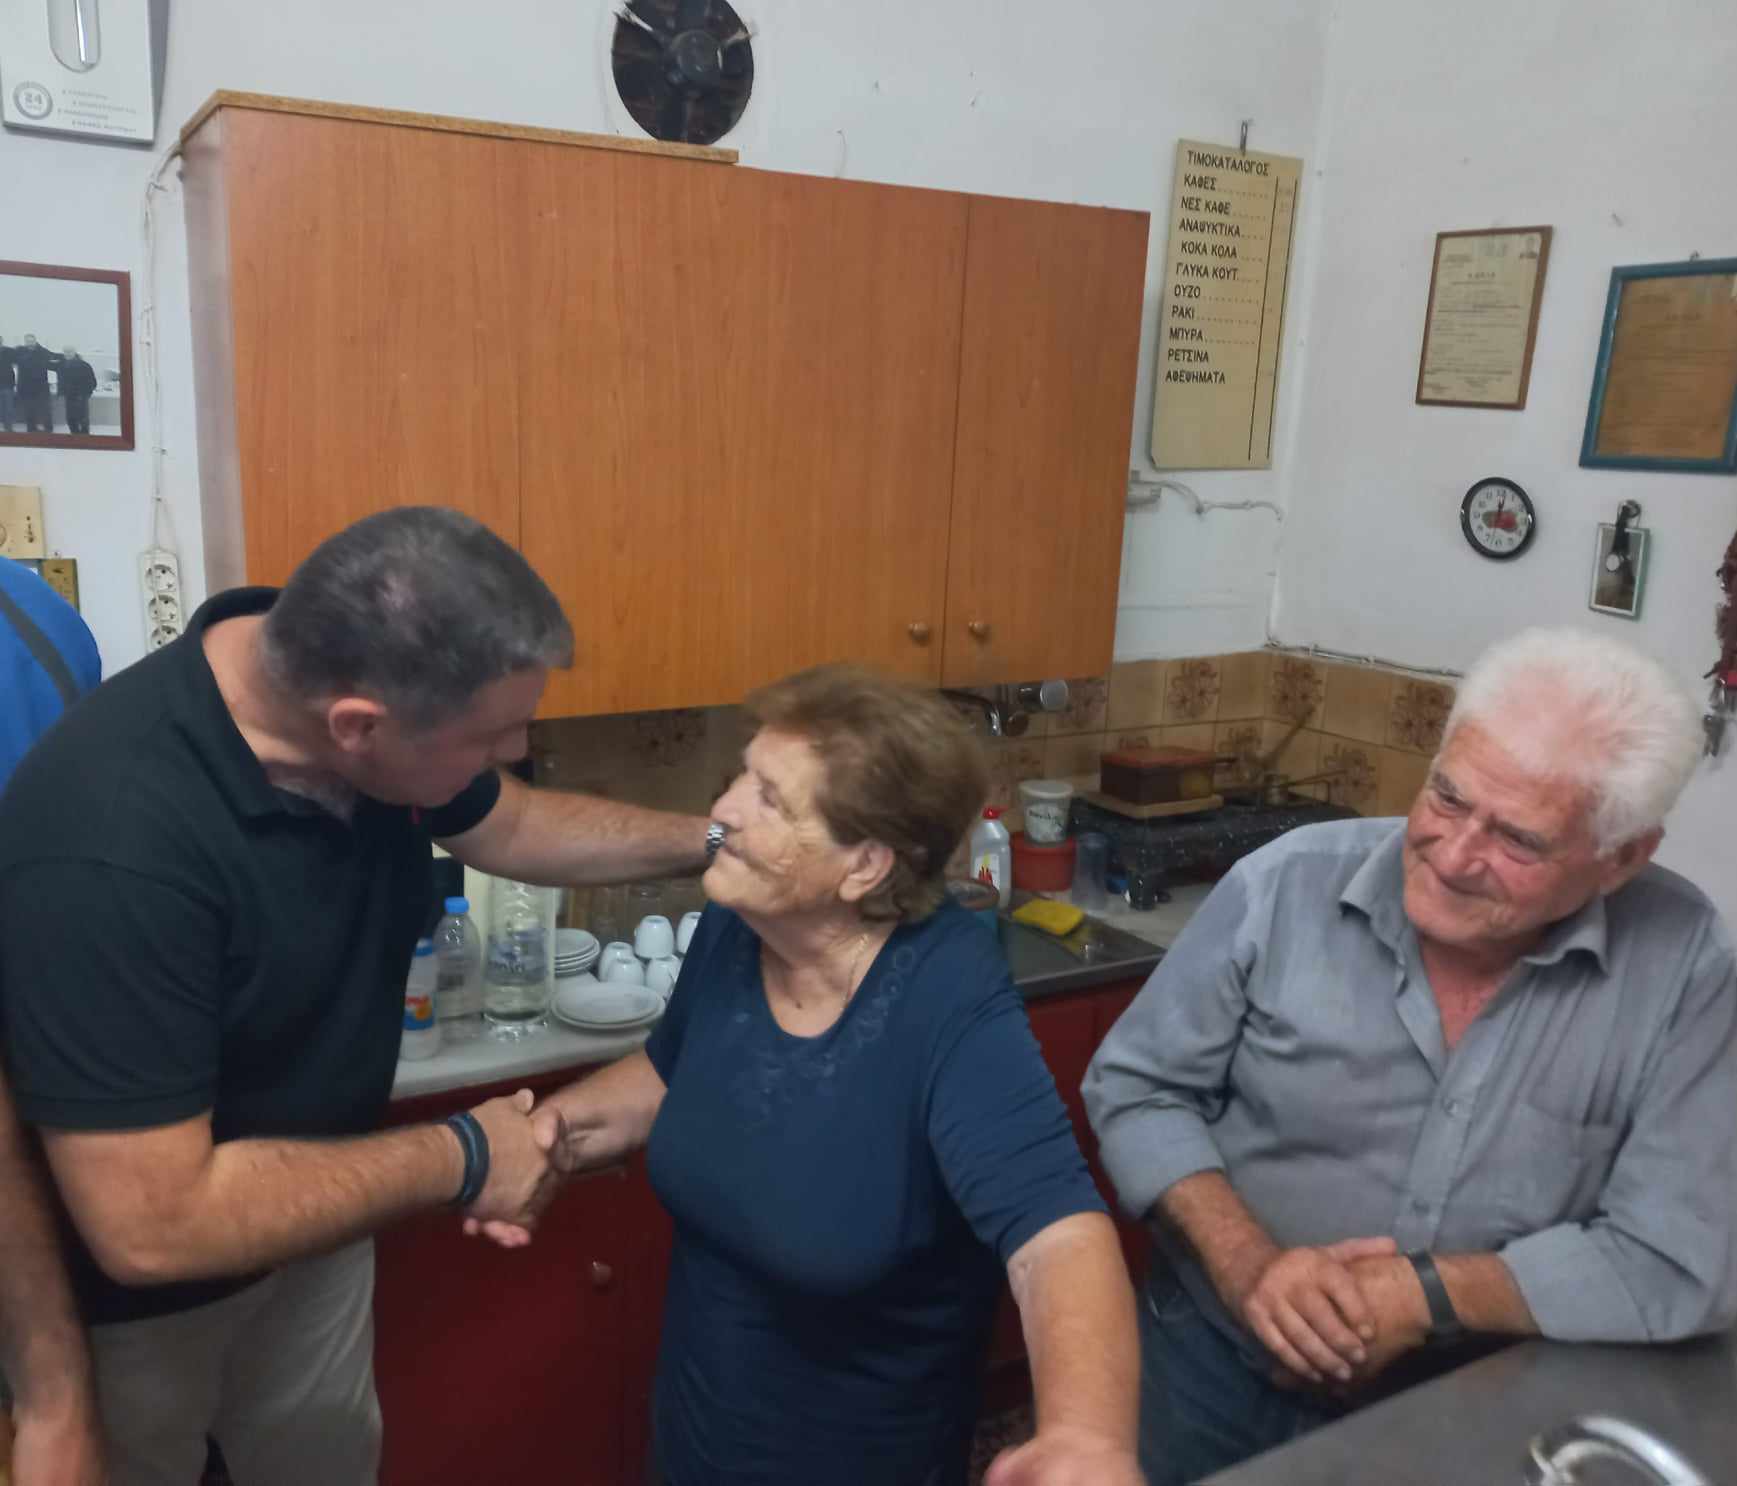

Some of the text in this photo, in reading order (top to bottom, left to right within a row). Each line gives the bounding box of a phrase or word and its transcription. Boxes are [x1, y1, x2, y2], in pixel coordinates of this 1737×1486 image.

[1188, 150, 1270, 176] ΤΙΜΟΚΑΤΑΛΟΓΟΣ
[1184, 173, 1216, 191] ΚΑΦΕΣ
[1181, 196, 1231, 215] ΝΕΣ ΚΑΦΕ
[1179, 218, 1241, 238] ΑΝΑΨΥΚΤΙΚΑ
[1181, 240, 1237, 258] ΚΟΚΑ ΚΟΛΑ
[1176, 262, 1209, 279] ΓΛΥΚΑ
[1174, 284, 1201, 299] ΟΥΖΟ
[1171, 305, 1195, 320] ΡΑΚΙ
[1169, 327, 1204, 342] ΜΠΥΡΑ
[1167, 348, 1209, 363] ΡΕΤΣΙΝΑ
[1165, 370, 1226, 385] ΑΦΕΨΗΜΑΤΑ
